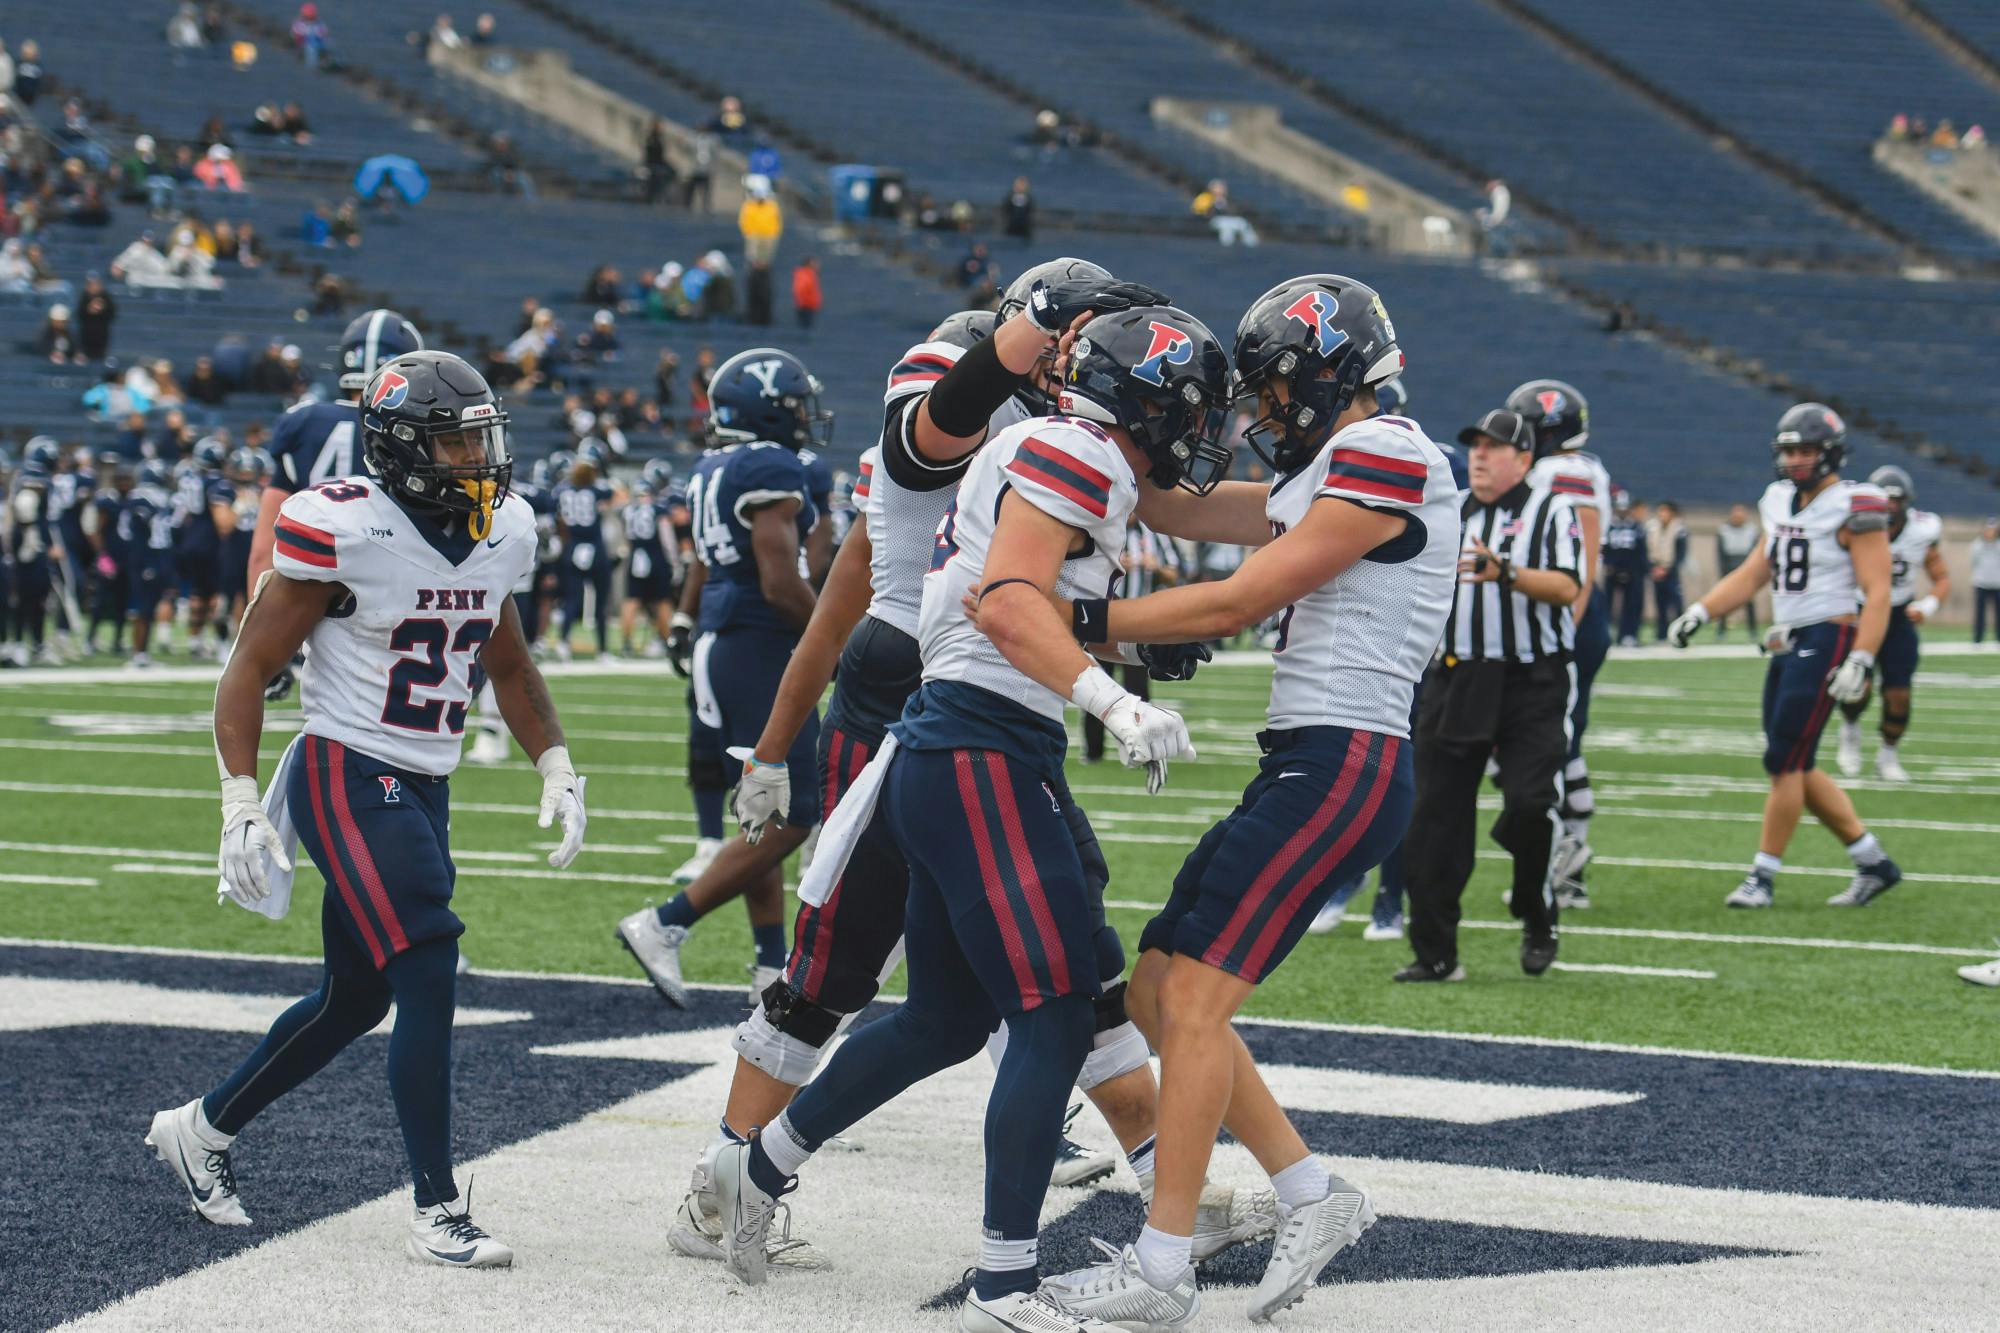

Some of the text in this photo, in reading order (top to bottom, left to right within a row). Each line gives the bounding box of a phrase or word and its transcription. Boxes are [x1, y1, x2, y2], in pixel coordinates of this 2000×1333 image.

[1130, 321, 1194, 388] P
[743, 361, 783, 398] Y
[370, 527, 386, 539] Ivy
[415, 588, 488, 611] PENN
[380, 617, 494, 735] 23
[378, 776, 401, 803] P
